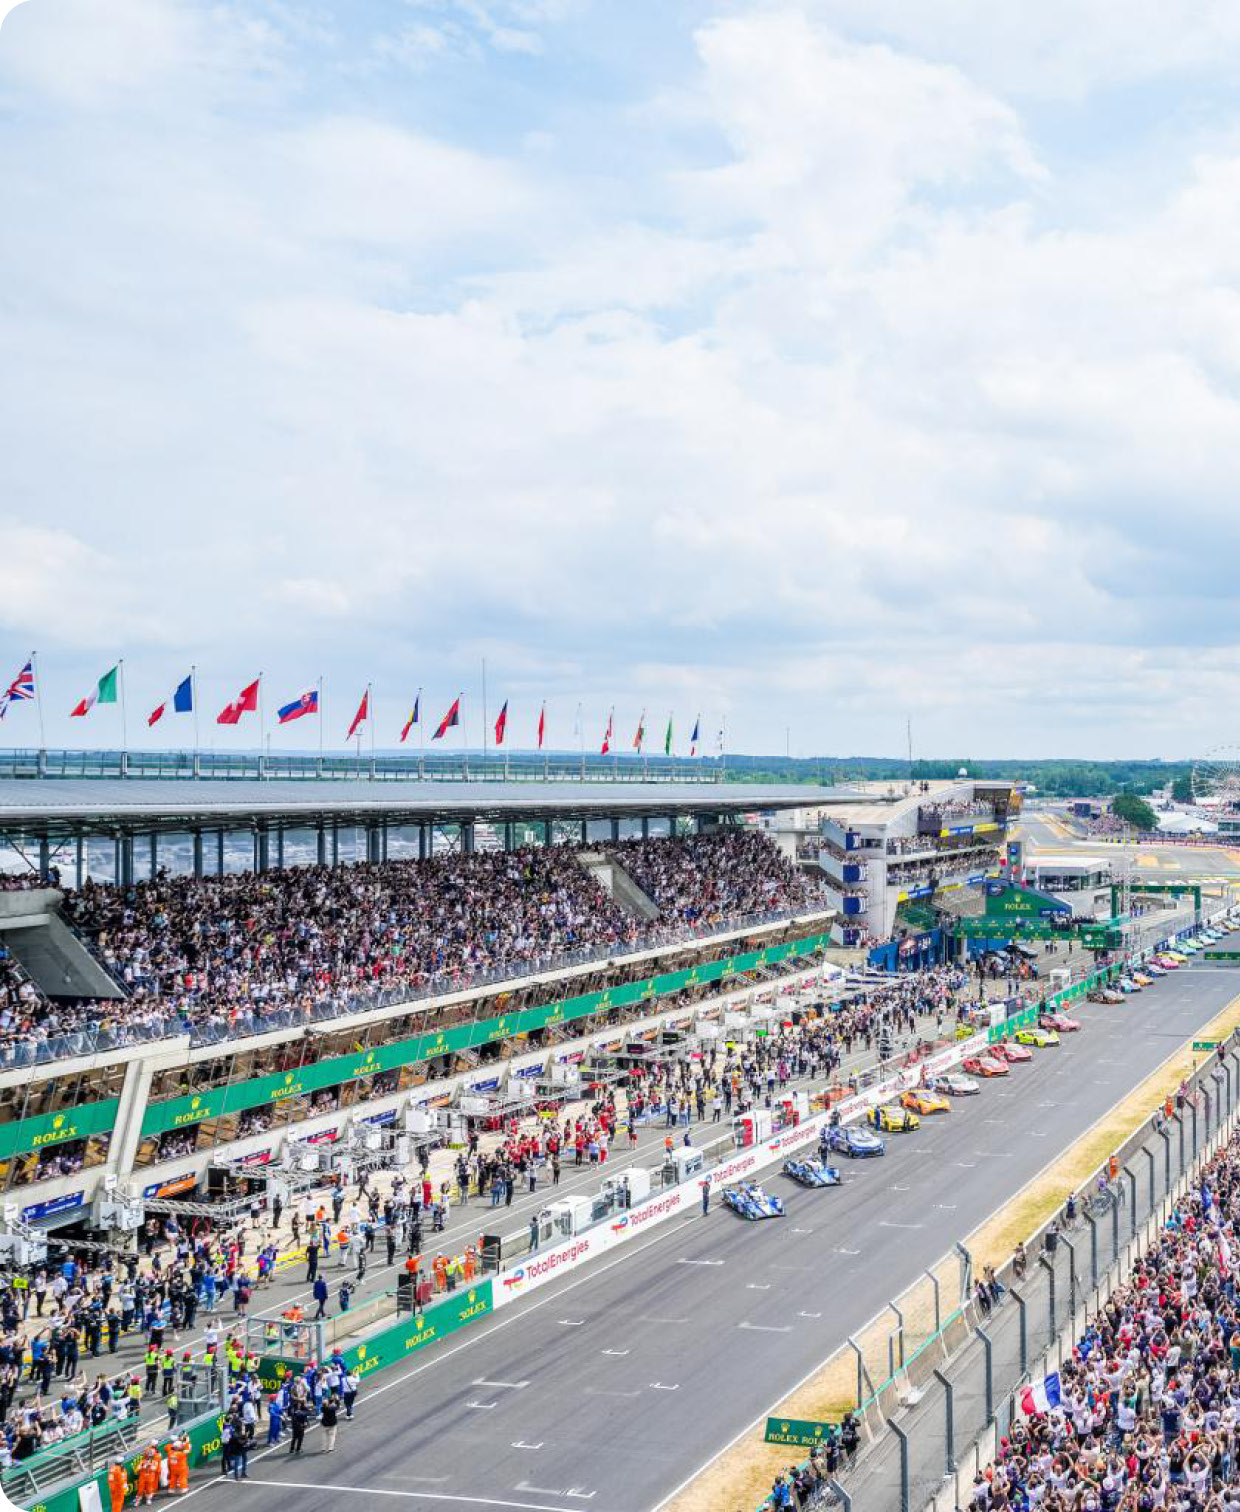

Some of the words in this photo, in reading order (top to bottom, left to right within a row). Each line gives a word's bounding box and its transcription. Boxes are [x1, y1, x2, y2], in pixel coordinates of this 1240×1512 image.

[1004, 903, 1032, 911] ROLEX
[271, 1084, 302, 1098] ROLEX
[175, 1107, 211, 1125] ROLEX
[32, 1127, 77, 1146] ROLEX
[711, 1155, 756, 1184] TotalEnergies
[629, 1193, 681, 1227] TotalEnergies
[526, 1239, 590, 1279] TotalEnergies
[459, 1301, 487, 1321] ROLEX
[405, 1326, 435, 1349] ROLEX
[351, 1355, 379, 1375] OLEX
[768, 1433, 799, 1443] ROLEX
